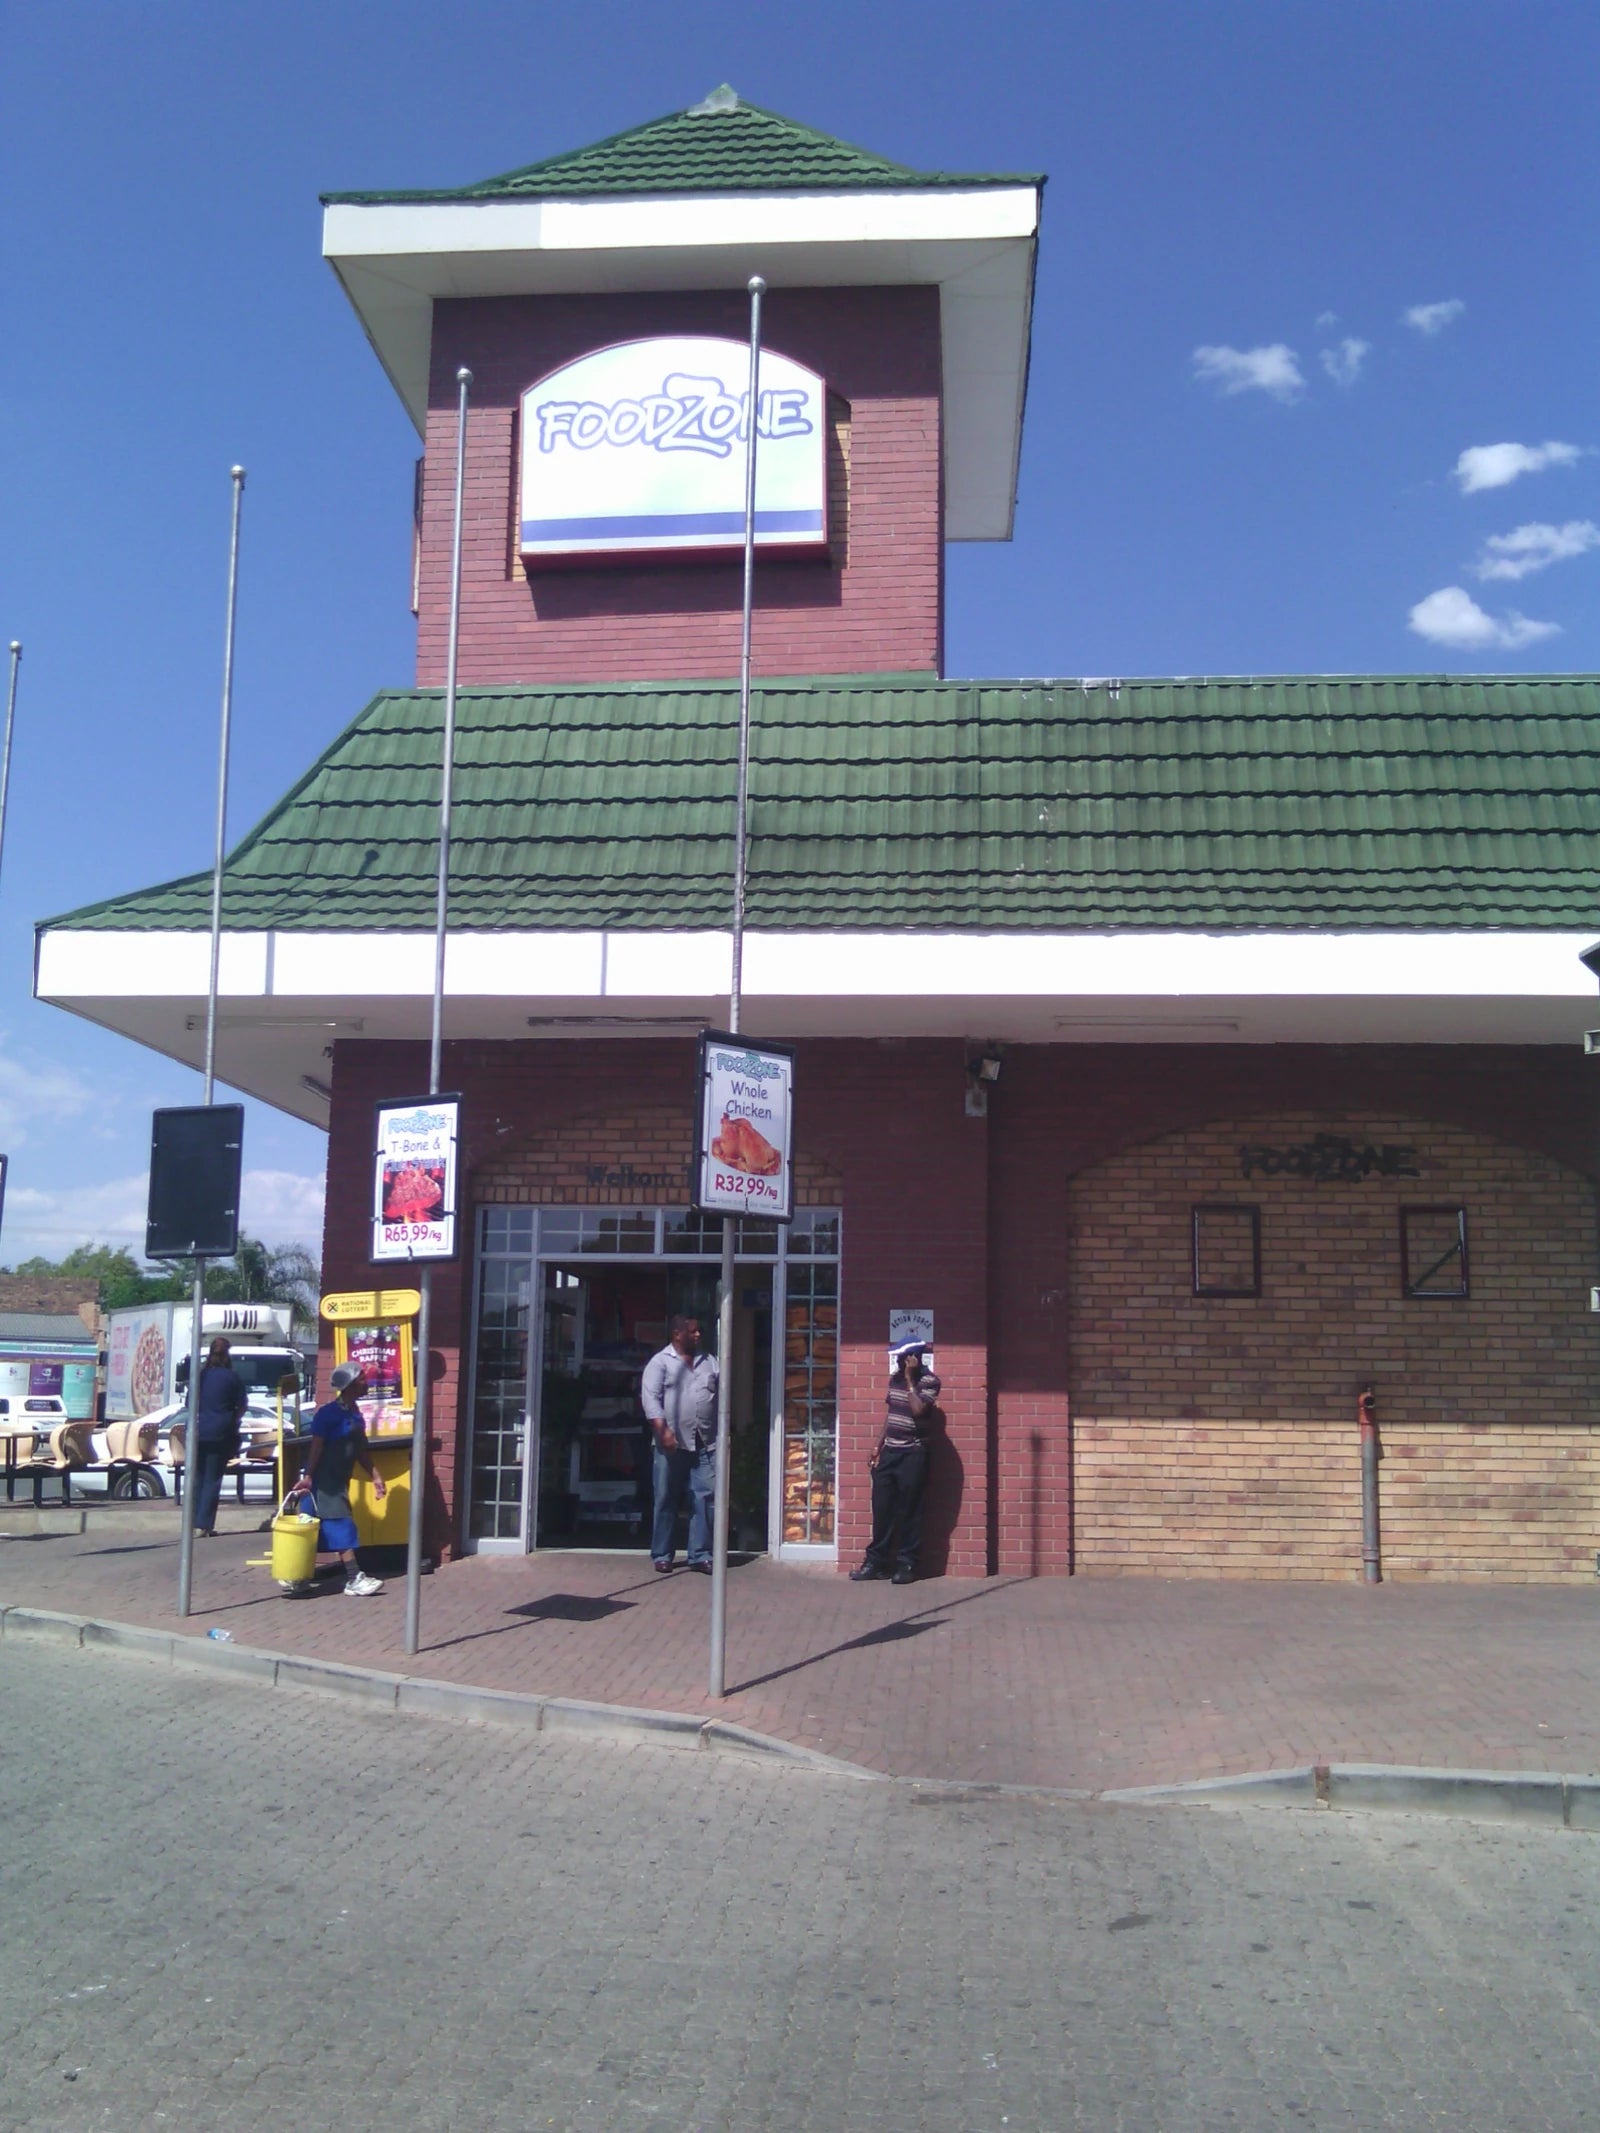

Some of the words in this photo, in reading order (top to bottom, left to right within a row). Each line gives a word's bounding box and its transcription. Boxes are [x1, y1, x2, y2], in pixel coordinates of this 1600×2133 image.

[537, 372, 813, 458] FOODZONE
[716, 1051, 780, 1082] FOODZONE
[731, 1080, 768, 1100] Whole
[726, 1099, 772, 1120] Chicken
[388, 1110, 447, 1135] FOODZONE
[913, 1315, 932, 1329] FORCE
[351, 1346, 397, 1358] CHRISTMAS
[359, 1355, 388, 1363] RAFFLE
